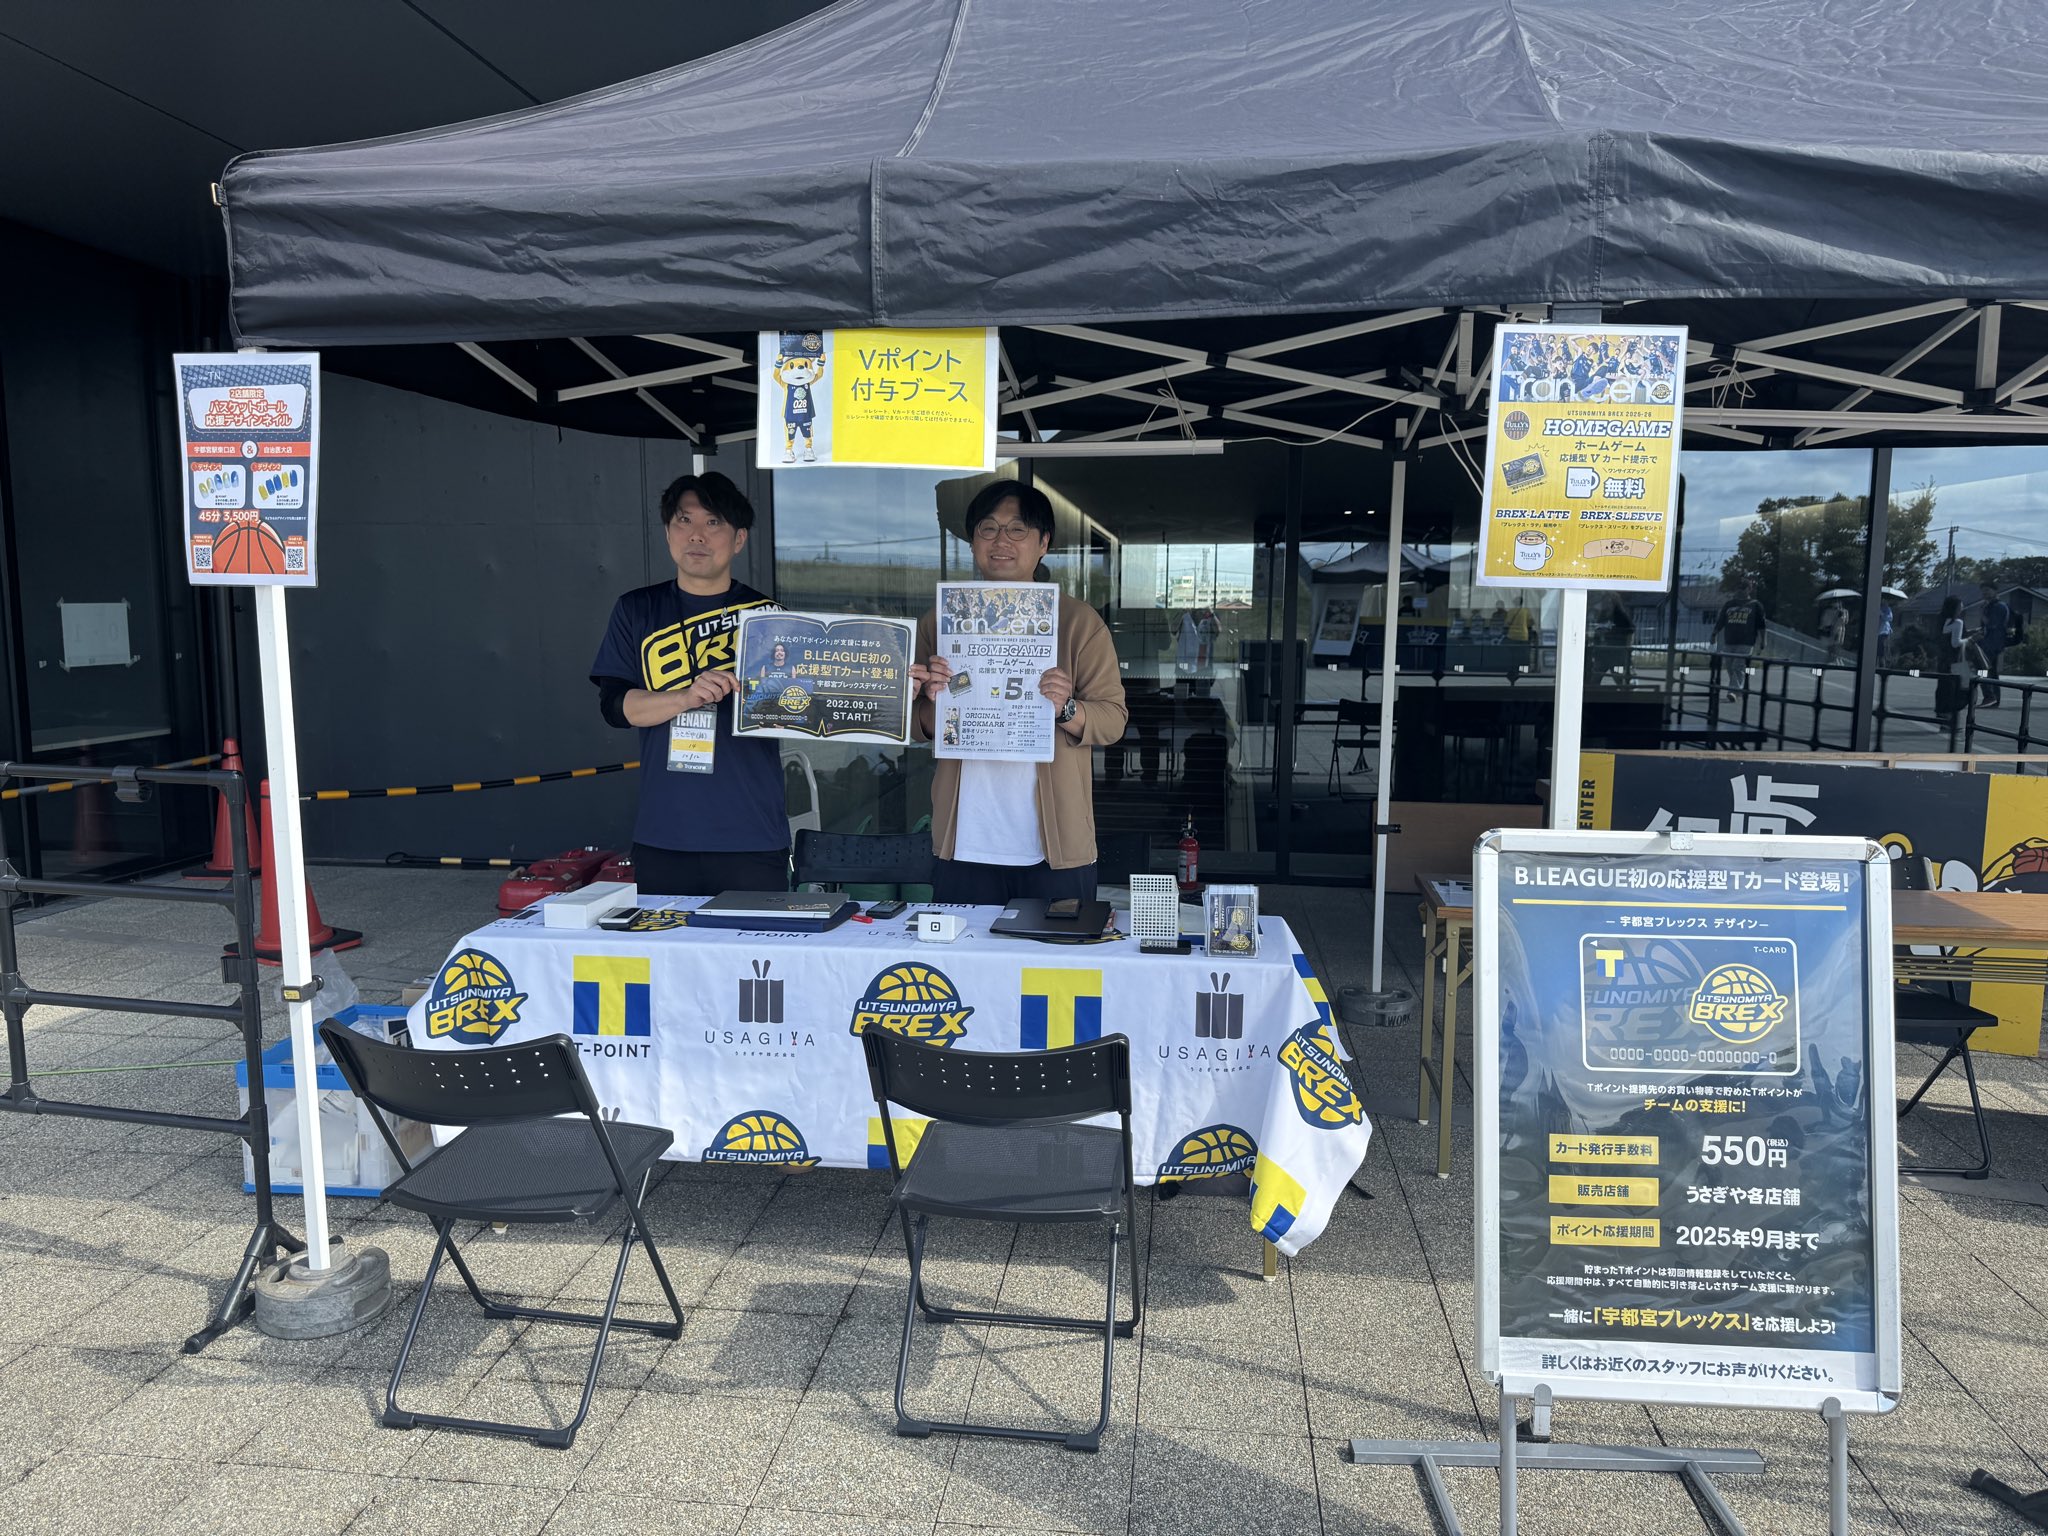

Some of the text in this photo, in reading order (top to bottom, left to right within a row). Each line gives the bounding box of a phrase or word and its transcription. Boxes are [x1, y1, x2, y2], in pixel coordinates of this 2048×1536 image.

[859, 347, 961, 373] Vポイント
[851, 377, 968, 402] 付与ブース
[209, 400, 287, 413] バスケットボール
[205, 414, 292, 427] 応援デザインネイル
[1542, 419, 1673, 438] HOMEGAME
[246, 445, 253, 454] &
[1574, 440, 1646, 452] ホームゲーム
[1559, 454, 1658, 464] 応援型 V カード提示で
[1604, 477, 1646, 499] 無料
[199, 510, 260, 522] 45分 3,500円
[1495, 509, 1571, 520] BREX-LATTE
[1580, 511, 1663, 522] BREX-SLEEVE
[804, 649, 891, 665] B.LEAGUE初の
[968, 644, 1052, 657] HOMEGAME
[987, 658, 1034, 667] ホームゲーム
[796, 662, 898, 680] 応援型Tカード登場!
[1004, 677, 1023, 701] 5
[1024, 691, 1034, 701] 倍
[826, 699, 879, 710] 2022.09.01
[676, 712, 713, 728] TENANT
[833, 711, 872, 722] START!
[962, 720, 1005, 728] BOOKMARK
[965, 712, 1001, 720] ORIGINAL
[1514, 866, 1849, 893] B.LEAGUE初の応援型Tカード登場!
[736, 931, 812, 939] T-POINT
[1753, 946, 1787, 954] T-CARD
[428, 987, 511, 1012] UTSUNOMIYA
[859, 1001, 957, 1013] UTSUNOMIYA
[1698, 994, 1772, 1004] UTSUNOMIYA
[429, 995, 525, 1036] BREX
[1694, 1000, 1783, 1021] BREX
[704, 1031, 815, 1047] USAGIYA
[575, 1042, 651, 1058] T-POINT
[1158, 1044, 1271, 1061] USAGIYA
[1610, 1047, 1777, 1065] 0000-0000-0000000-0
[1279, 1041, 1362, 1122] BREX
[1587, 1082, 1803, 1098] Tポイント提携先のお買い物等で貯めたTポイントが
[1644, 1098, 1746, 1113] チームの支援に!
[705, 1150, 804, 1162] UTSUNOMIYA
[1556, 1142, 1653, 1157] カード発行手数料
[1161, 1155, 1257, 1175] UTSUNOMIYA
[1577, 1184, 1630, 1198] 販売店舗
[1686, 1185, 1801, 1206] うさぎや各店舗
[1557, 1223, 1655, 1239] ポイント応援期間
[1676, 1225, 1820, 1250] 2025年9月まで
[1584, 1264, 1796, 1281] 貯まったTポイントは初回情報登録をしていただくと、
[1546, 1276, 1835, 1296] 応援期間中は、すべて自動的に引き落としされチーム支援に繋がります。
[1548, 1306, 1836, 1335] 一緒に「宇都宮ブレックス」を応援しよう!
[1541, 1353, 1834, 1383] 詳しくはお近くのスタッフにお声がけください。
